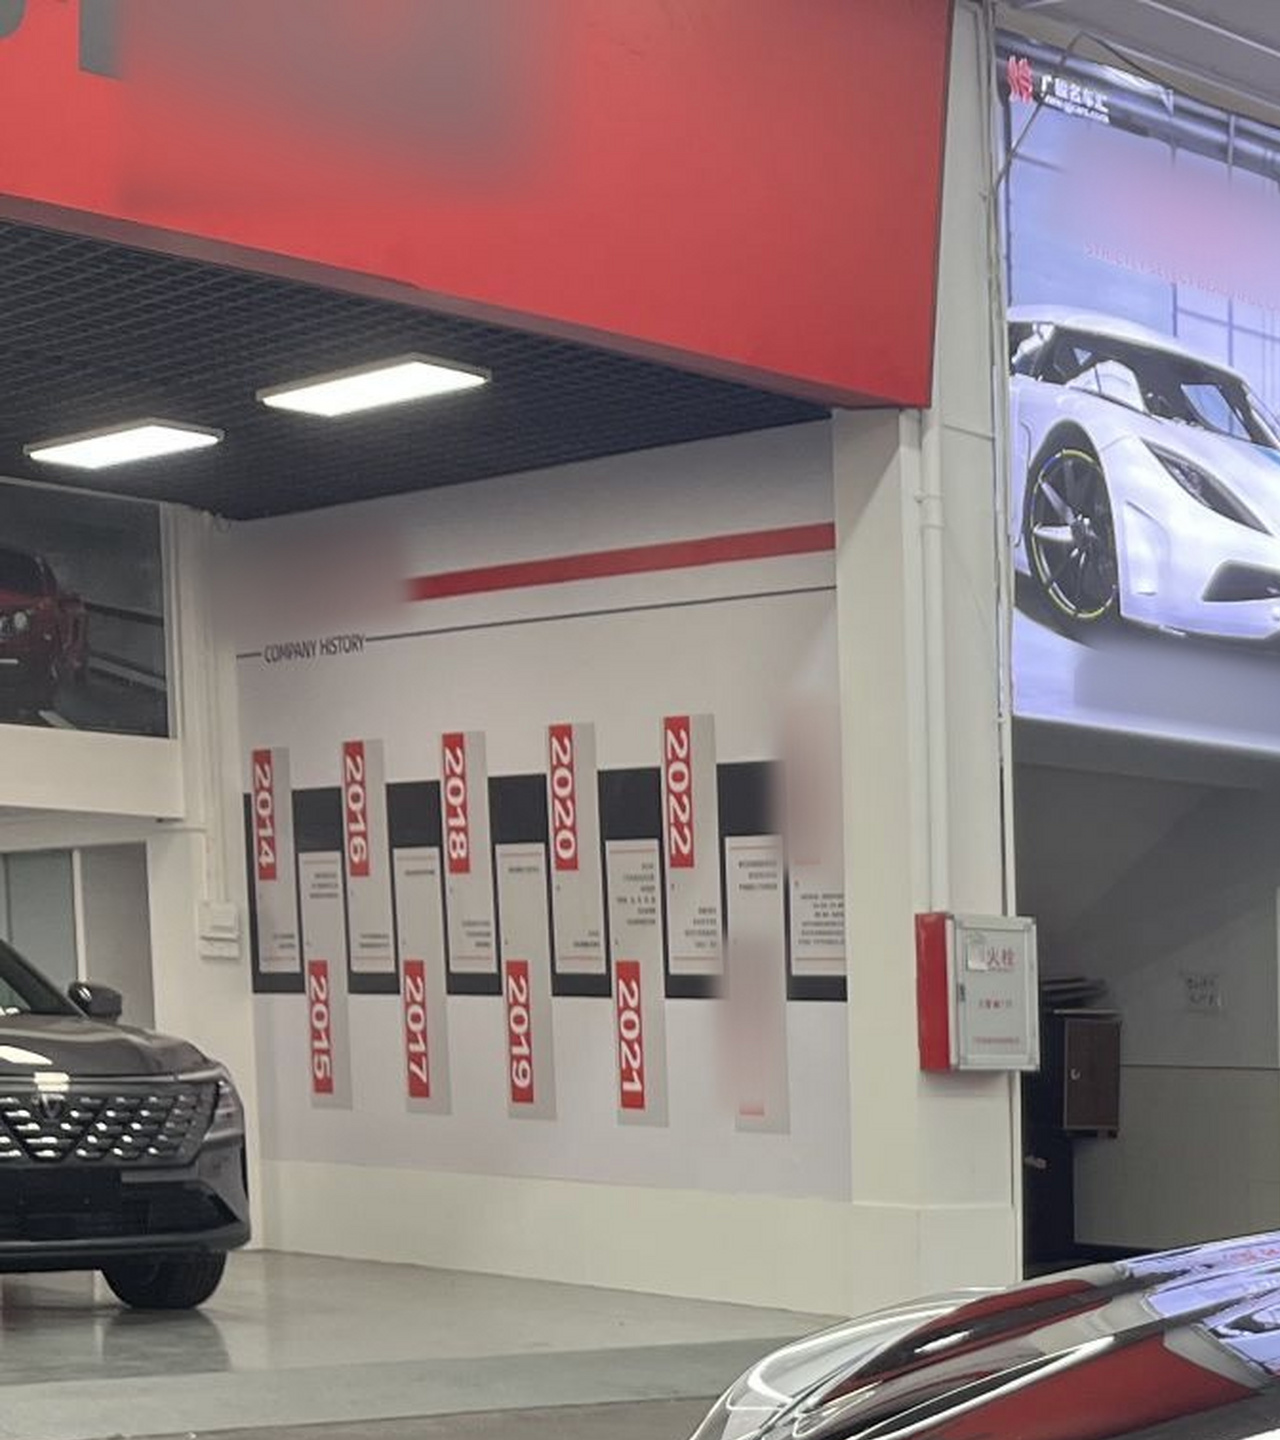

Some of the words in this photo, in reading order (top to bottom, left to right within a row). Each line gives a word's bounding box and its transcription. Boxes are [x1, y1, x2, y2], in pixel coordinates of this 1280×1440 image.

[264, 640, 317, 663] COMPANY
[320, 633, 365, 656] HISTORY
[255, 764, 275, 867] 2014
[346, 756, 367, 864] 2016
[445, 747, 467, 859] 2018
[552, 736, 576, 859] 2020
[667, 729, 692, 855] 2022
[310, 976, 330, 1080] 2015
[405, 976, 427, 1083] 2017
[508, 975, 531, 1089] 2019
[618, 979, 643, 1092] 2021
